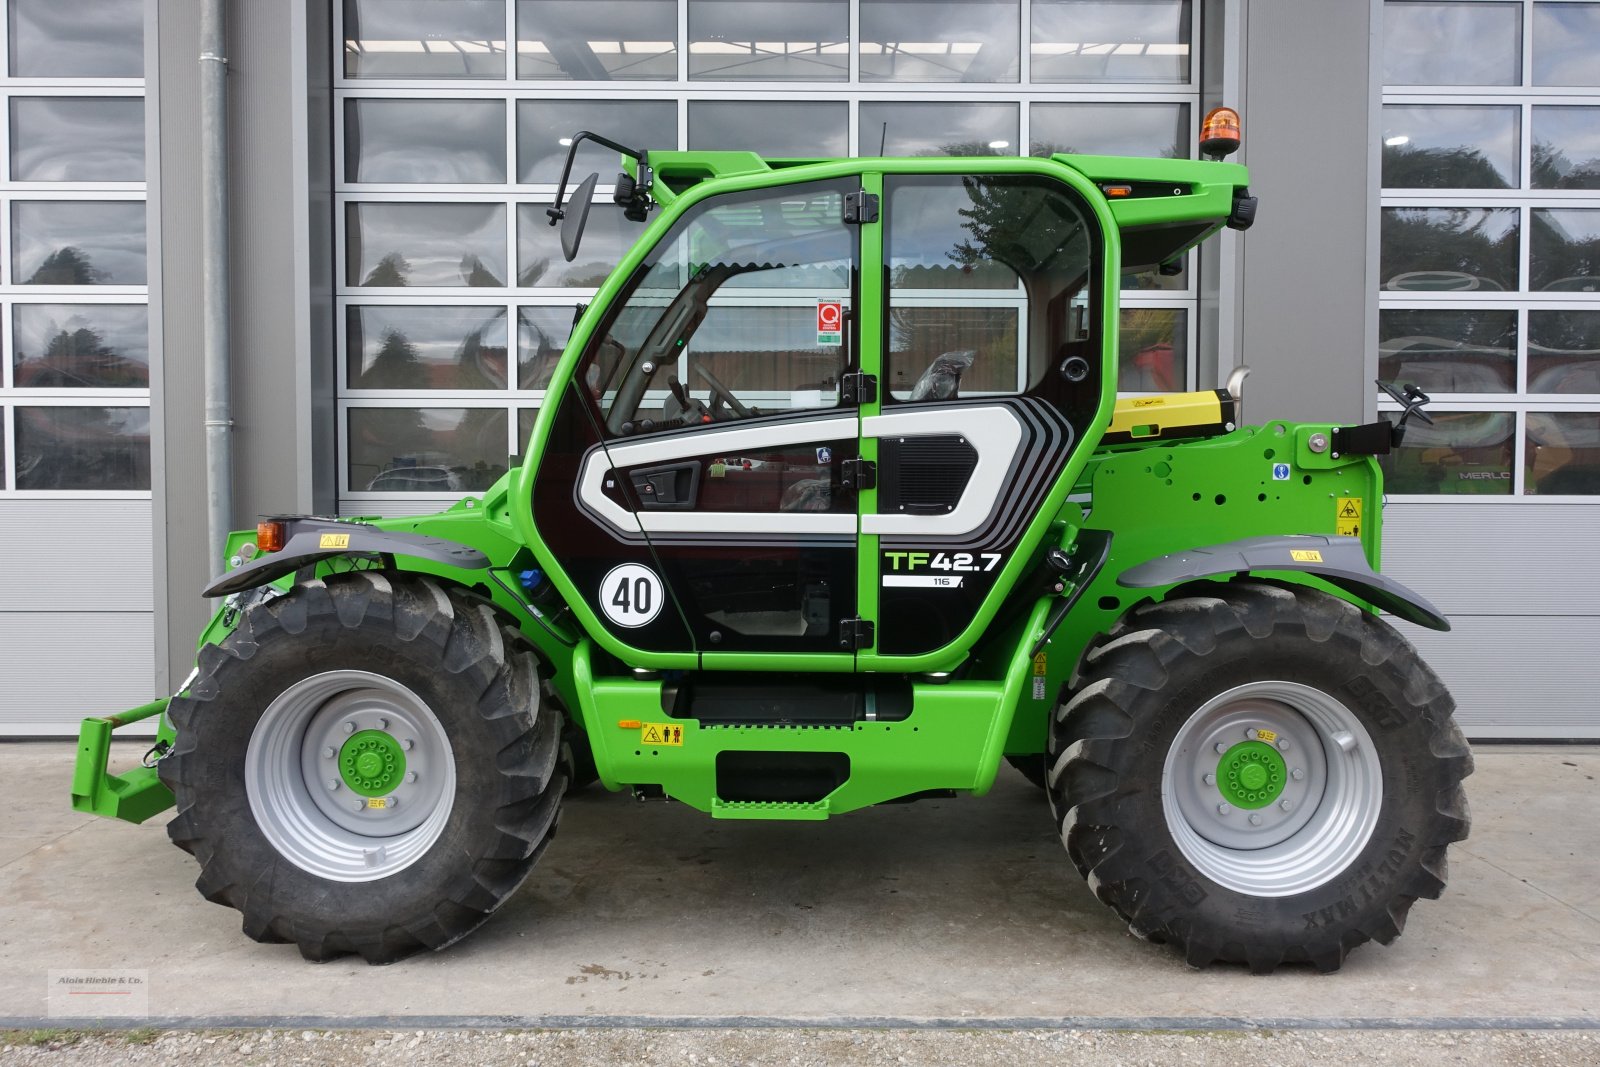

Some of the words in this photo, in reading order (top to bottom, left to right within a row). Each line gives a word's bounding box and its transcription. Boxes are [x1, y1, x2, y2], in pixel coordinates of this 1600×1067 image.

[884, 552, 1002, 572] TF42.7
[933, 578, 950, 586] 116
[612, 577, 652, 615] 40
